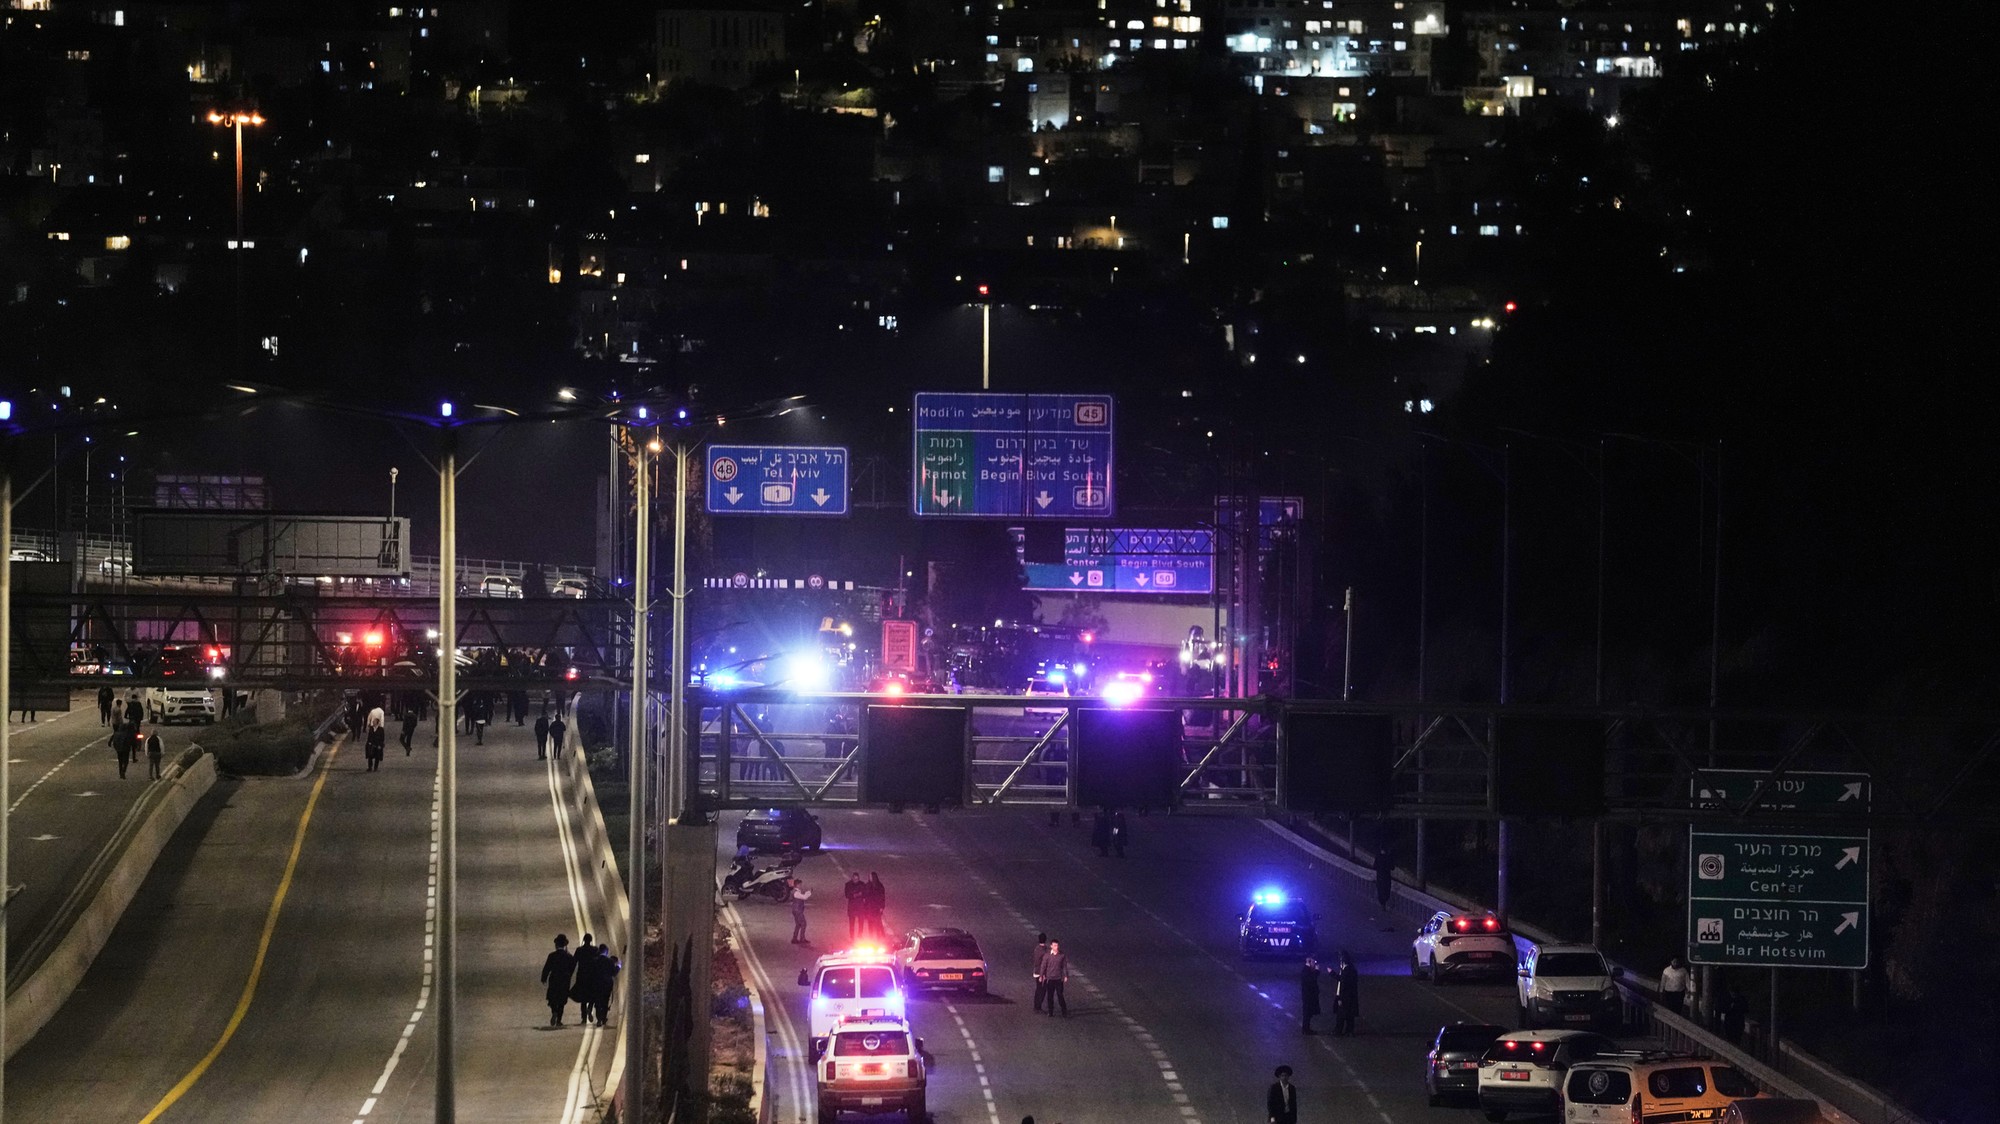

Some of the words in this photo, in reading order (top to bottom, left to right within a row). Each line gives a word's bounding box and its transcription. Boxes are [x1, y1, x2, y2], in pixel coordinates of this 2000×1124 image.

[919, 407, 965, 418] Modi'in
[1028, 407, 1072, 422] מודיעין
[1083, 408, 1099, 419] 45
[929, 437, 963, 448] רמות
[995, 438, 1026, 449] דרום
[1034, 438, 1057, 452] בגין
[741, 450, 763, 466] أبيب
[769, 452, 782, 467] تل
[788, 453, 818, 464] אביב
[825, 451, 843, 464] תל
[717, 464, 733, 474] 48
[763, 467, 783, 478] Tel
[790, 467, 821, 478] Aviv
[924, 470, 967, 480] Ramot
[981, 470, 1020, 483] Begin
[1026, 470, 1056, 481] Blvd
[1063, 470, 1104, 481] South
[1066, 558, 1099, 567] Center
[1121, 559, 1148, 569] Begin
[1151, 559, 1173, 568] Blvd
[1177, 560, 1205, 568] South
[1754, 779, 1806, 793] עטרת
[1734, 843, 1772, 857] העיר
[1781, 843, 1822, 857] מרכז
[1740, 863, 1781, 876] المدينة
[1787, 864, 1815, 878] مركز
[1750, 880, 1804, 893] Center
[1734, 907, 1790, 921] חוצבים
[1798, 909, 1819, 921] הר
[1797, 929, 1814, 941] هار
[1726, 945, 1753, 956] Har
[1760, 945, 1826, 959] Hotsvim
